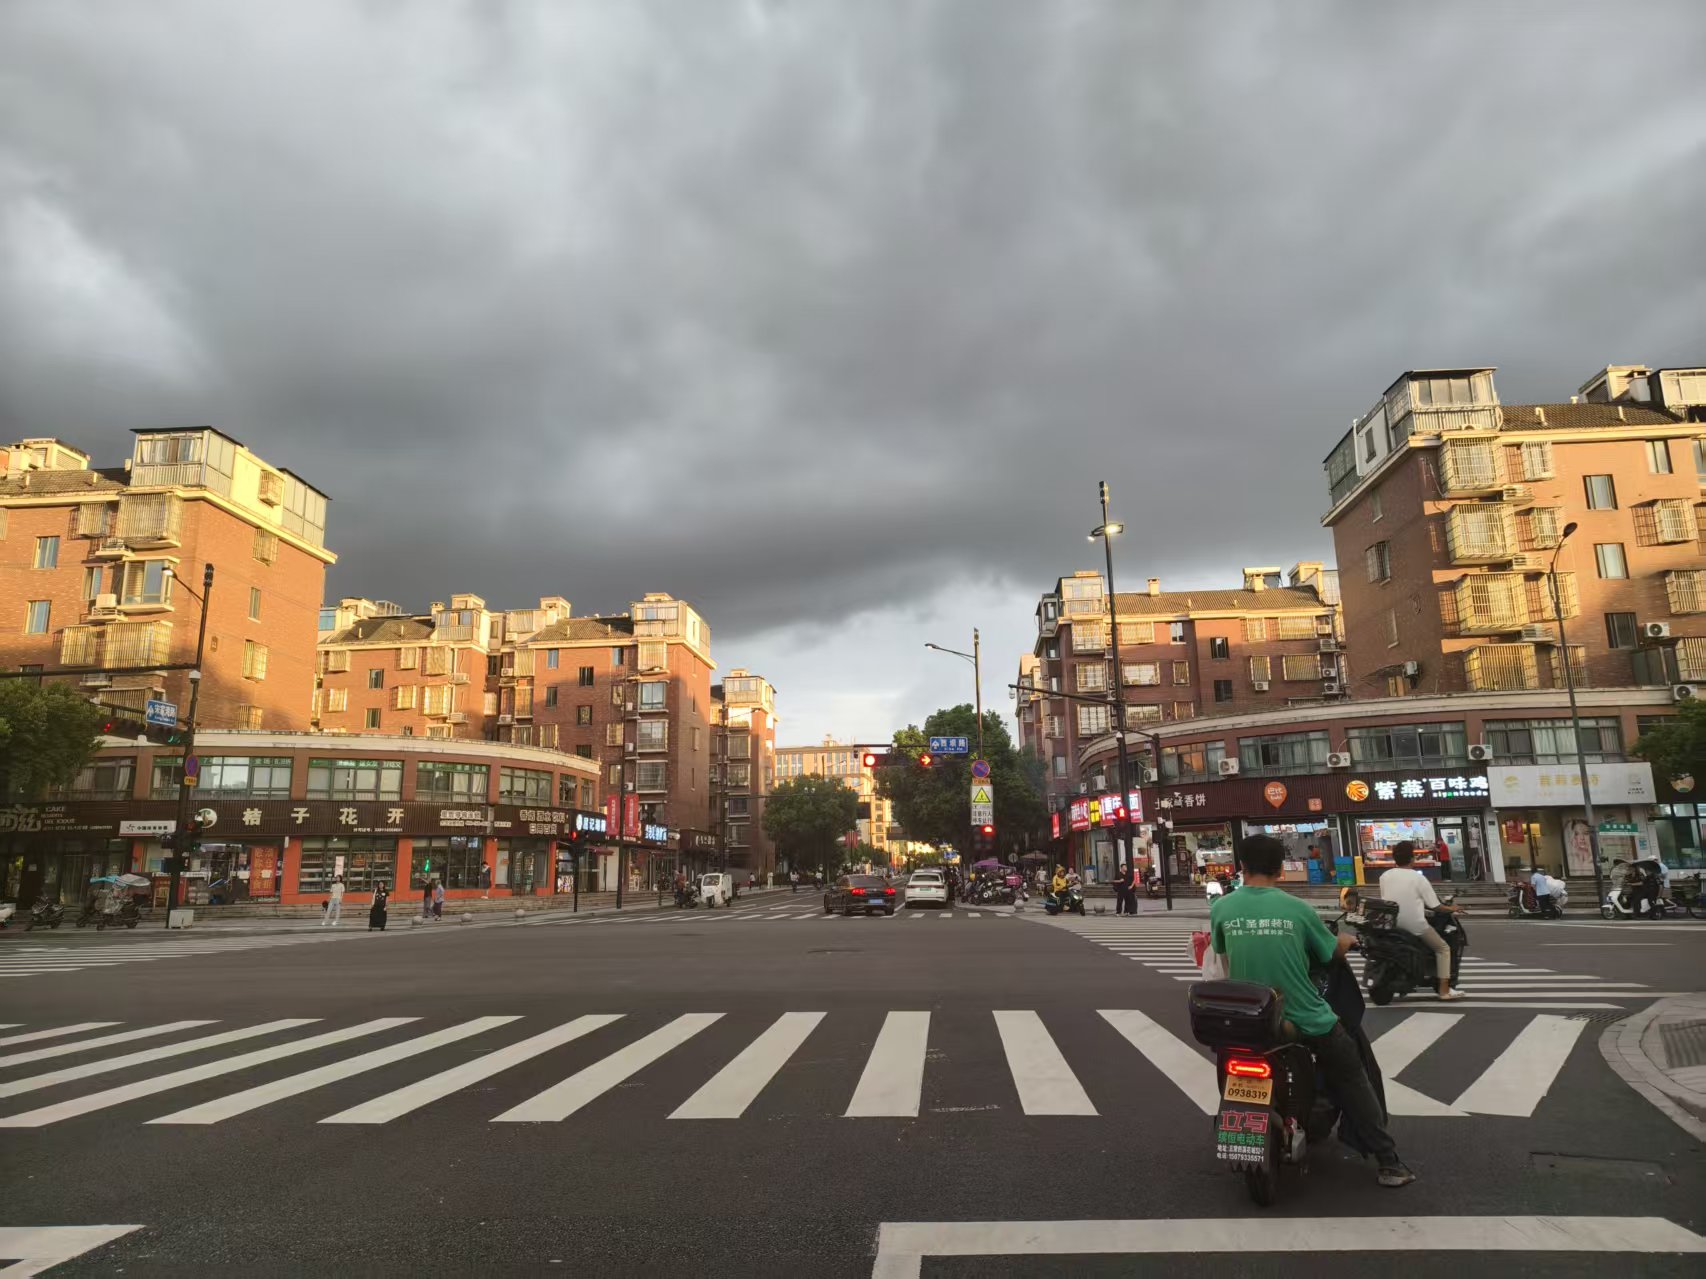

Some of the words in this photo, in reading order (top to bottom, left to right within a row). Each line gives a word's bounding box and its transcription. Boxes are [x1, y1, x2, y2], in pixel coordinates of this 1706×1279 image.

[1267, 787, 1284, 795] 巴比
[1374, 776, 1489, 800] 紫燕百味鸡
[242, 807, 404, 825] 桔子花开
[1246, 918, 1294, 930] 圣都装饰
[1228, 1088, 1268, 1100] 0938319
